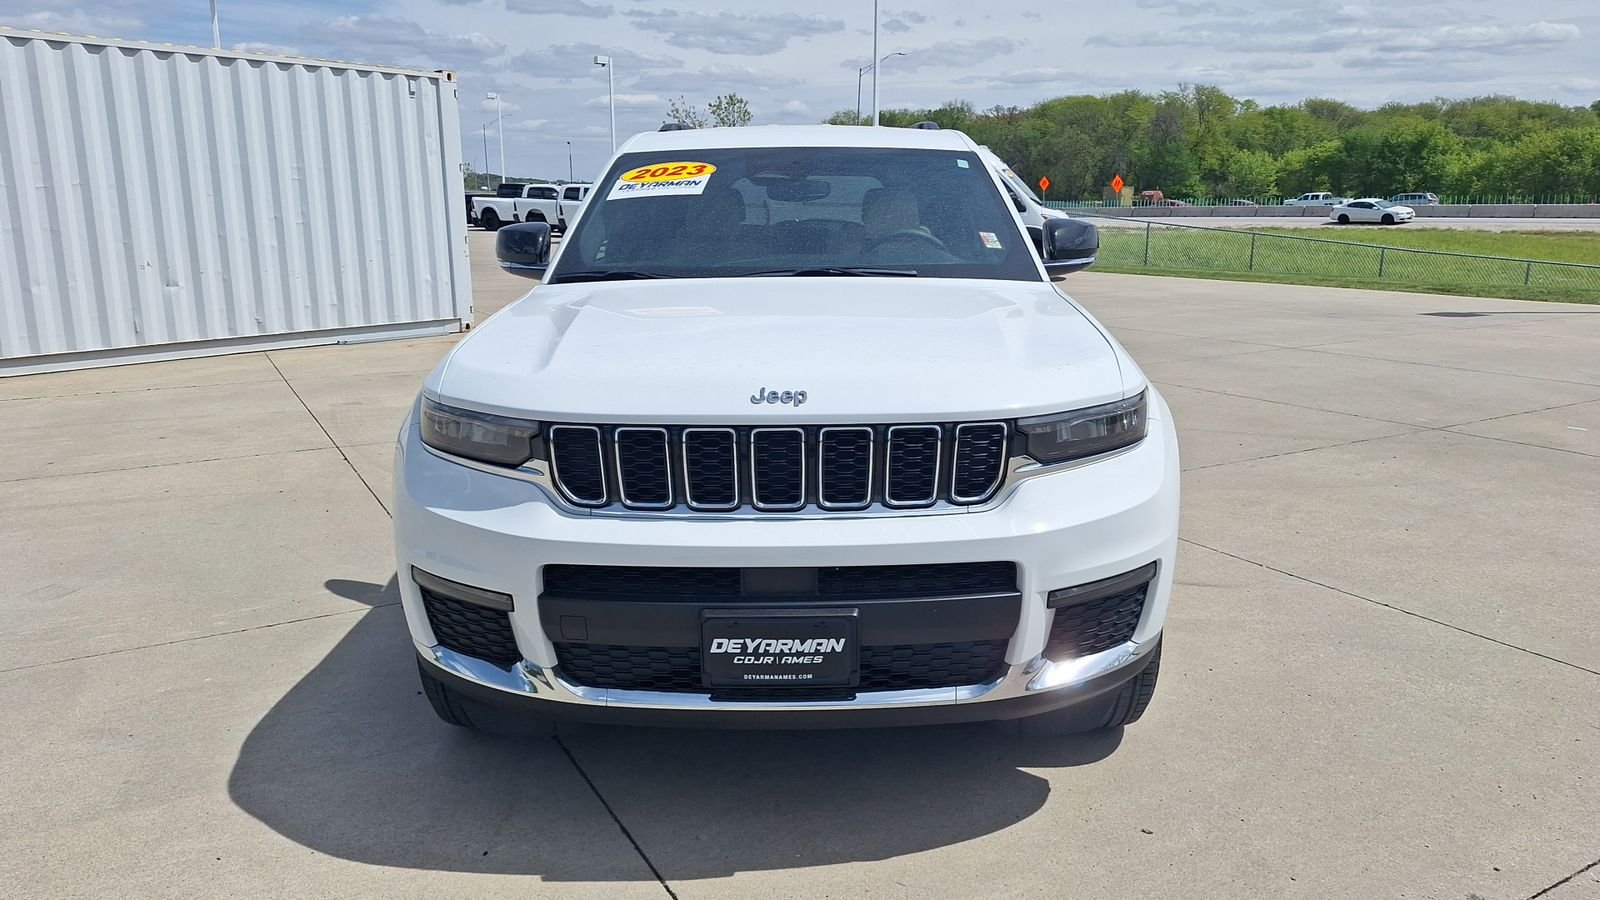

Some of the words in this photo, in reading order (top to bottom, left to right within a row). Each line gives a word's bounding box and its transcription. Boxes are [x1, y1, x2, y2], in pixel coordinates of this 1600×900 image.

[629, 165, 708, 180] 2023
[618, 180, 702, 191] DEYARMAN
[750, 387, 808, 407] Jeep
[710, 638, 846, 653] DEYARMAN
